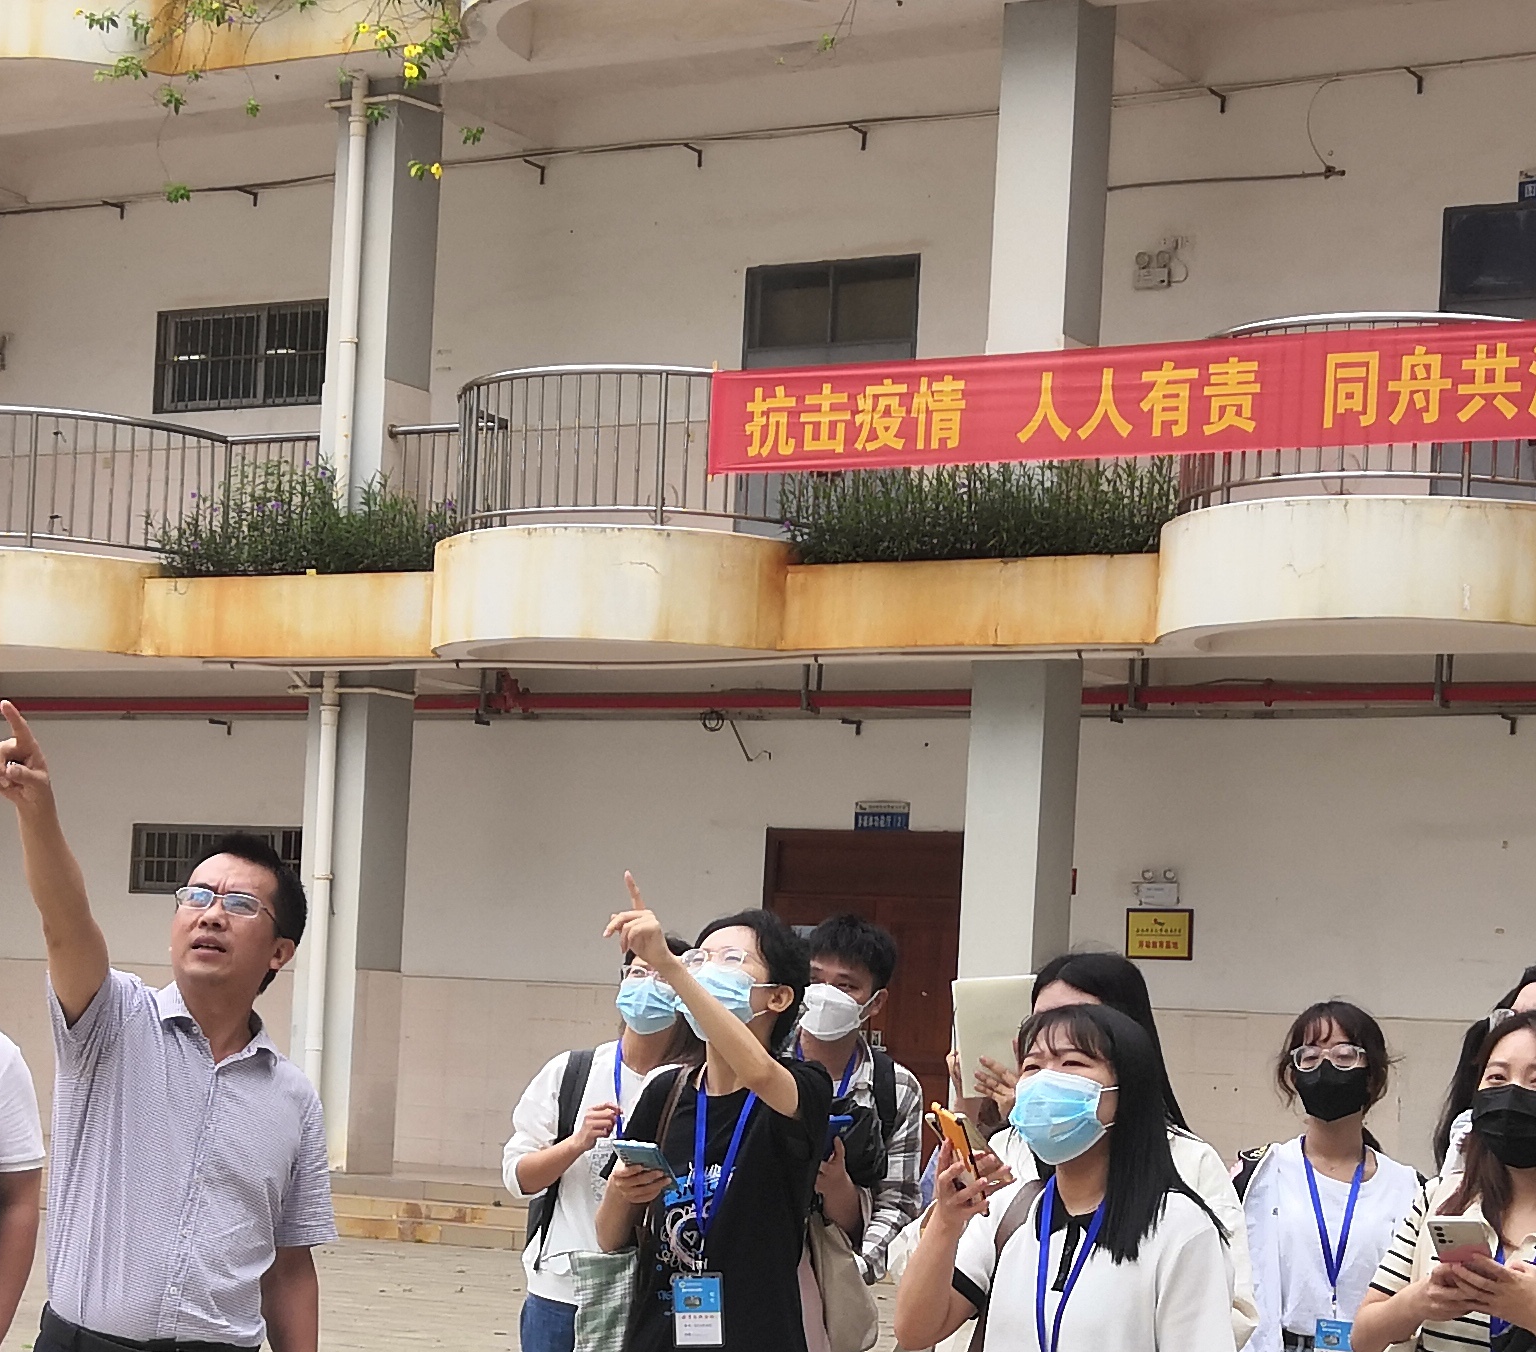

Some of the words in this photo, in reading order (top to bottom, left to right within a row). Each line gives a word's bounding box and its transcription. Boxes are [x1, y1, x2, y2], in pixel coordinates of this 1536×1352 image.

[744, 373, 967, 458] 抗击疫情
[1015, 356, 1263, 445] 人人有责
